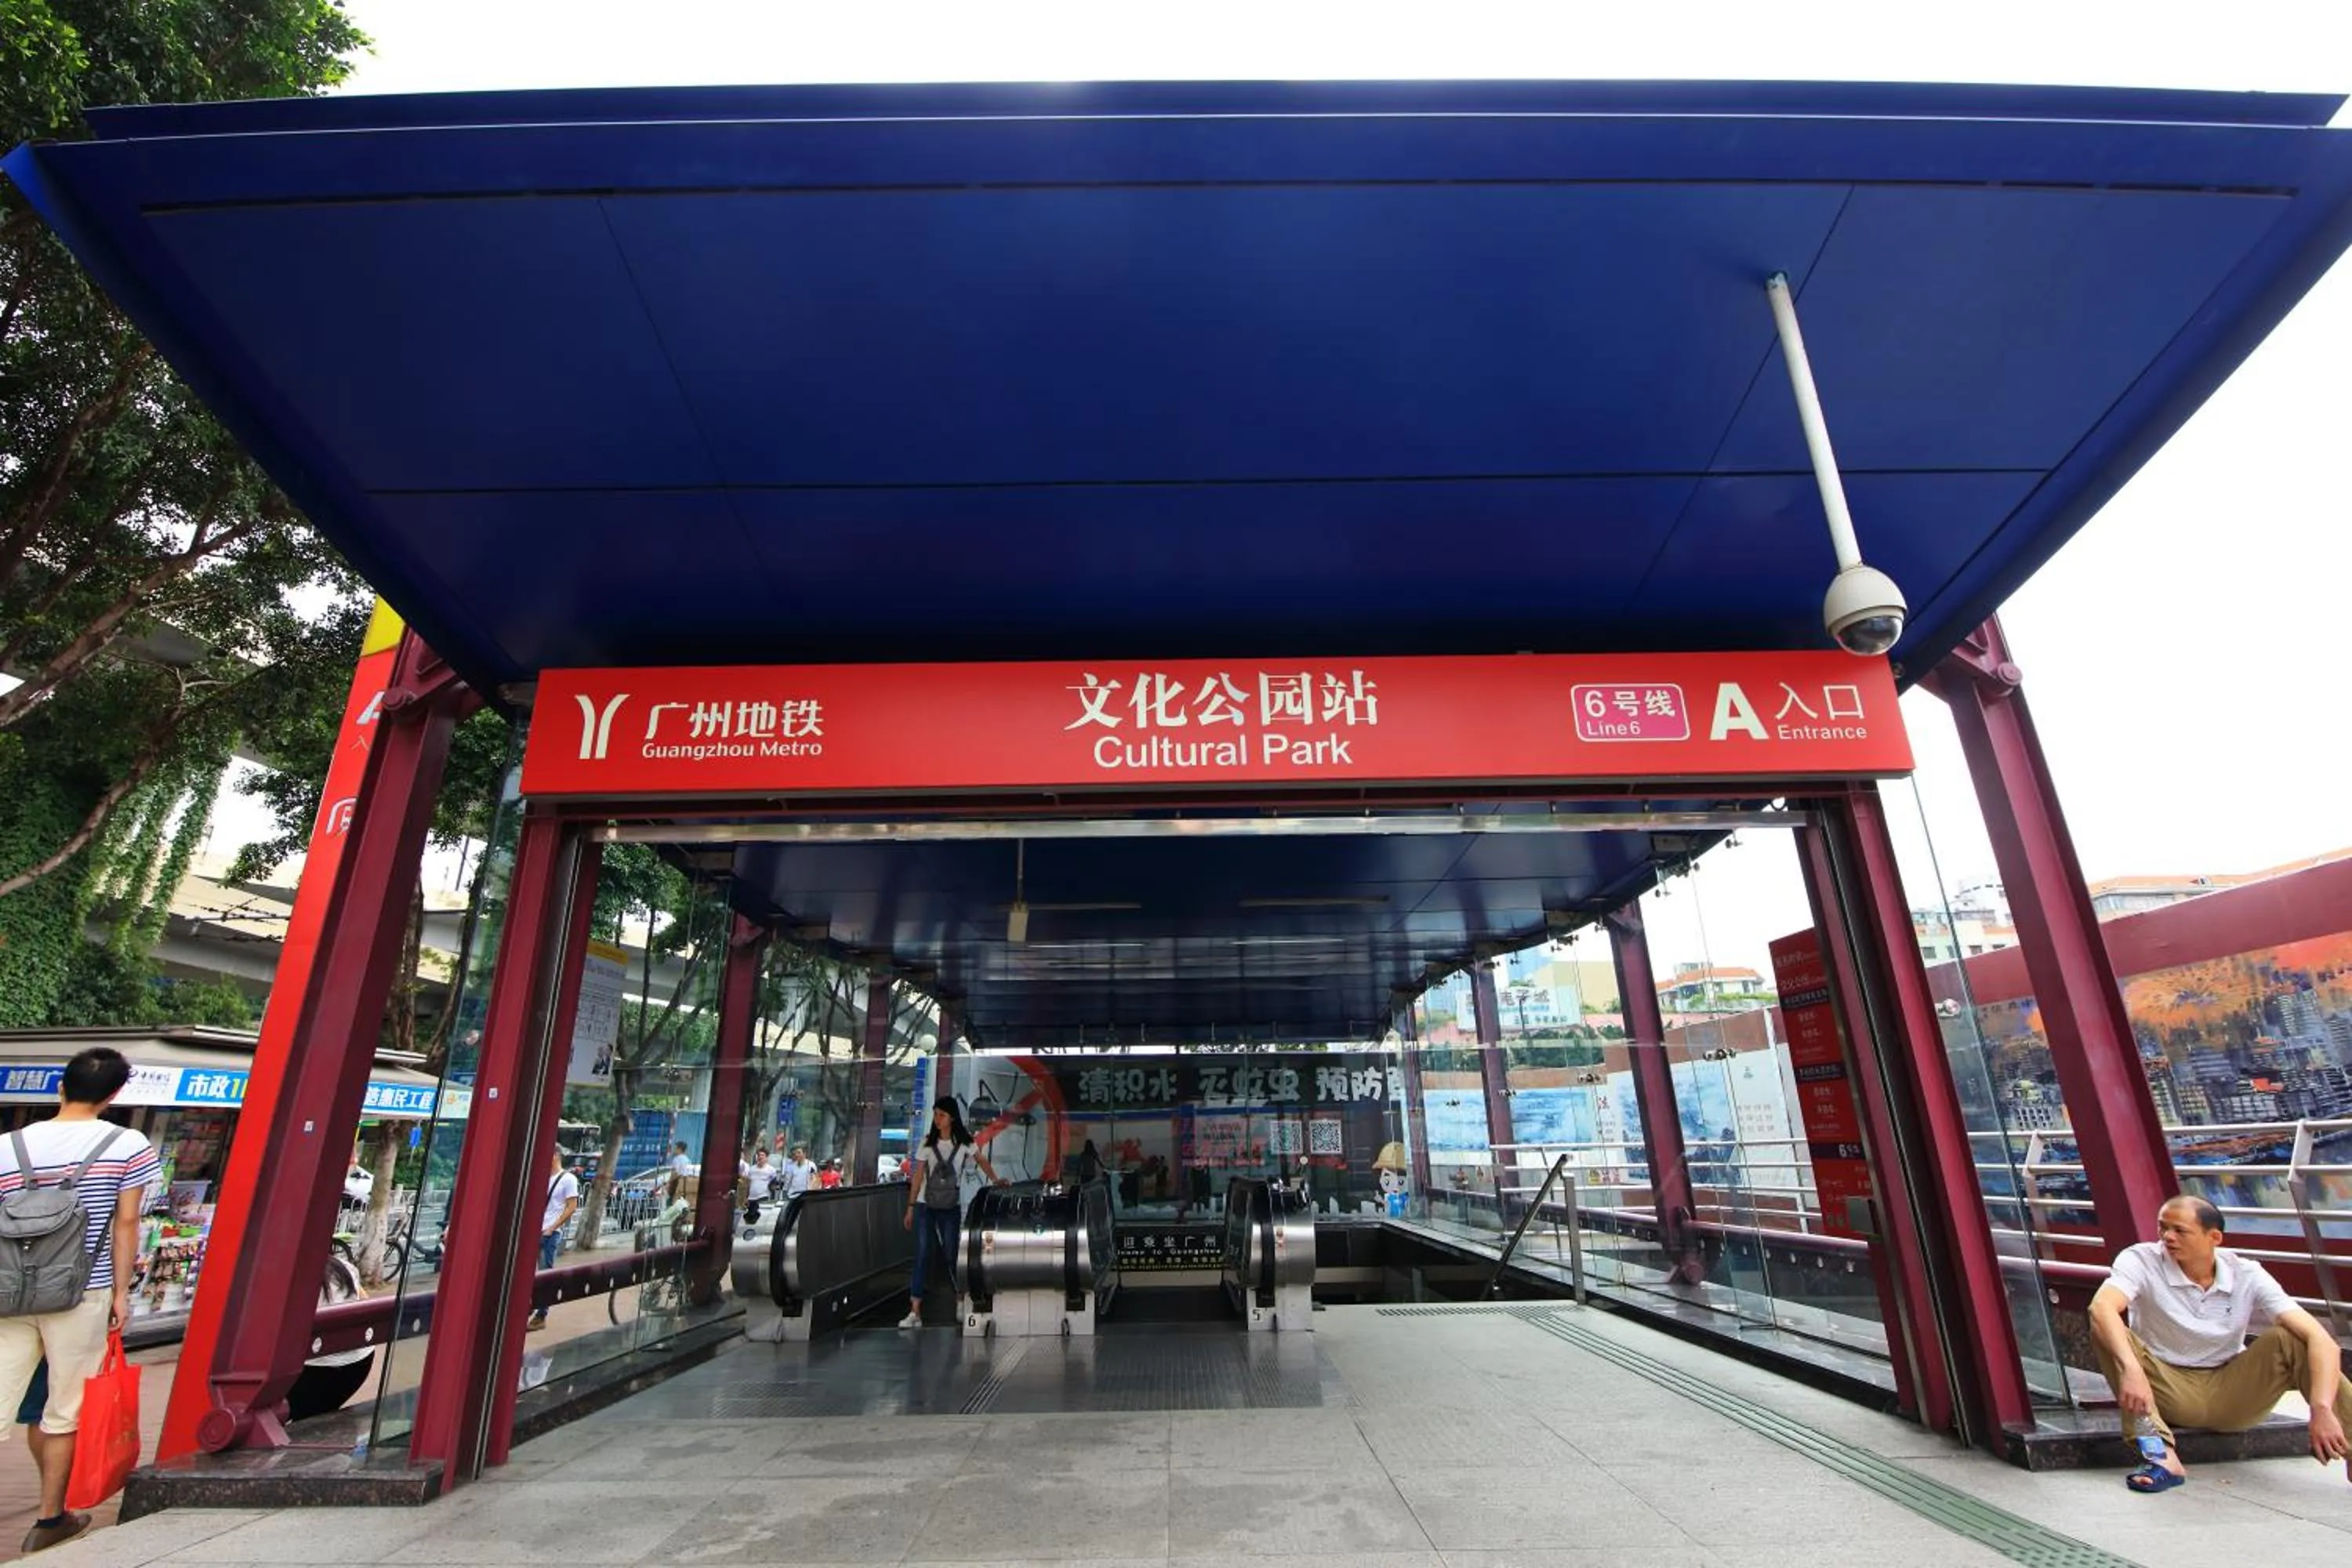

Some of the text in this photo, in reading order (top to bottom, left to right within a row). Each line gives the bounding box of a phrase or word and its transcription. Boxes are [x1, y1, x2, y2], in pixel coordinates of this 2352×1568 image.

[1064, 670, 1378, 731] 文化公园站
[1584, 690, 1676, 718] 6号线
[1709, 682, 1769, 741] A
[1775, 681, 1865, 720] 入口
[644, 700, 824, 740] 广州地铁
[1778, 724, 1867, 740] Entrance
[641, 740, 822, 760] Guangzhou Metro
[1093, 733, 1353, 768] Cultural Park
[967, 1315, 976, 1327] 6
